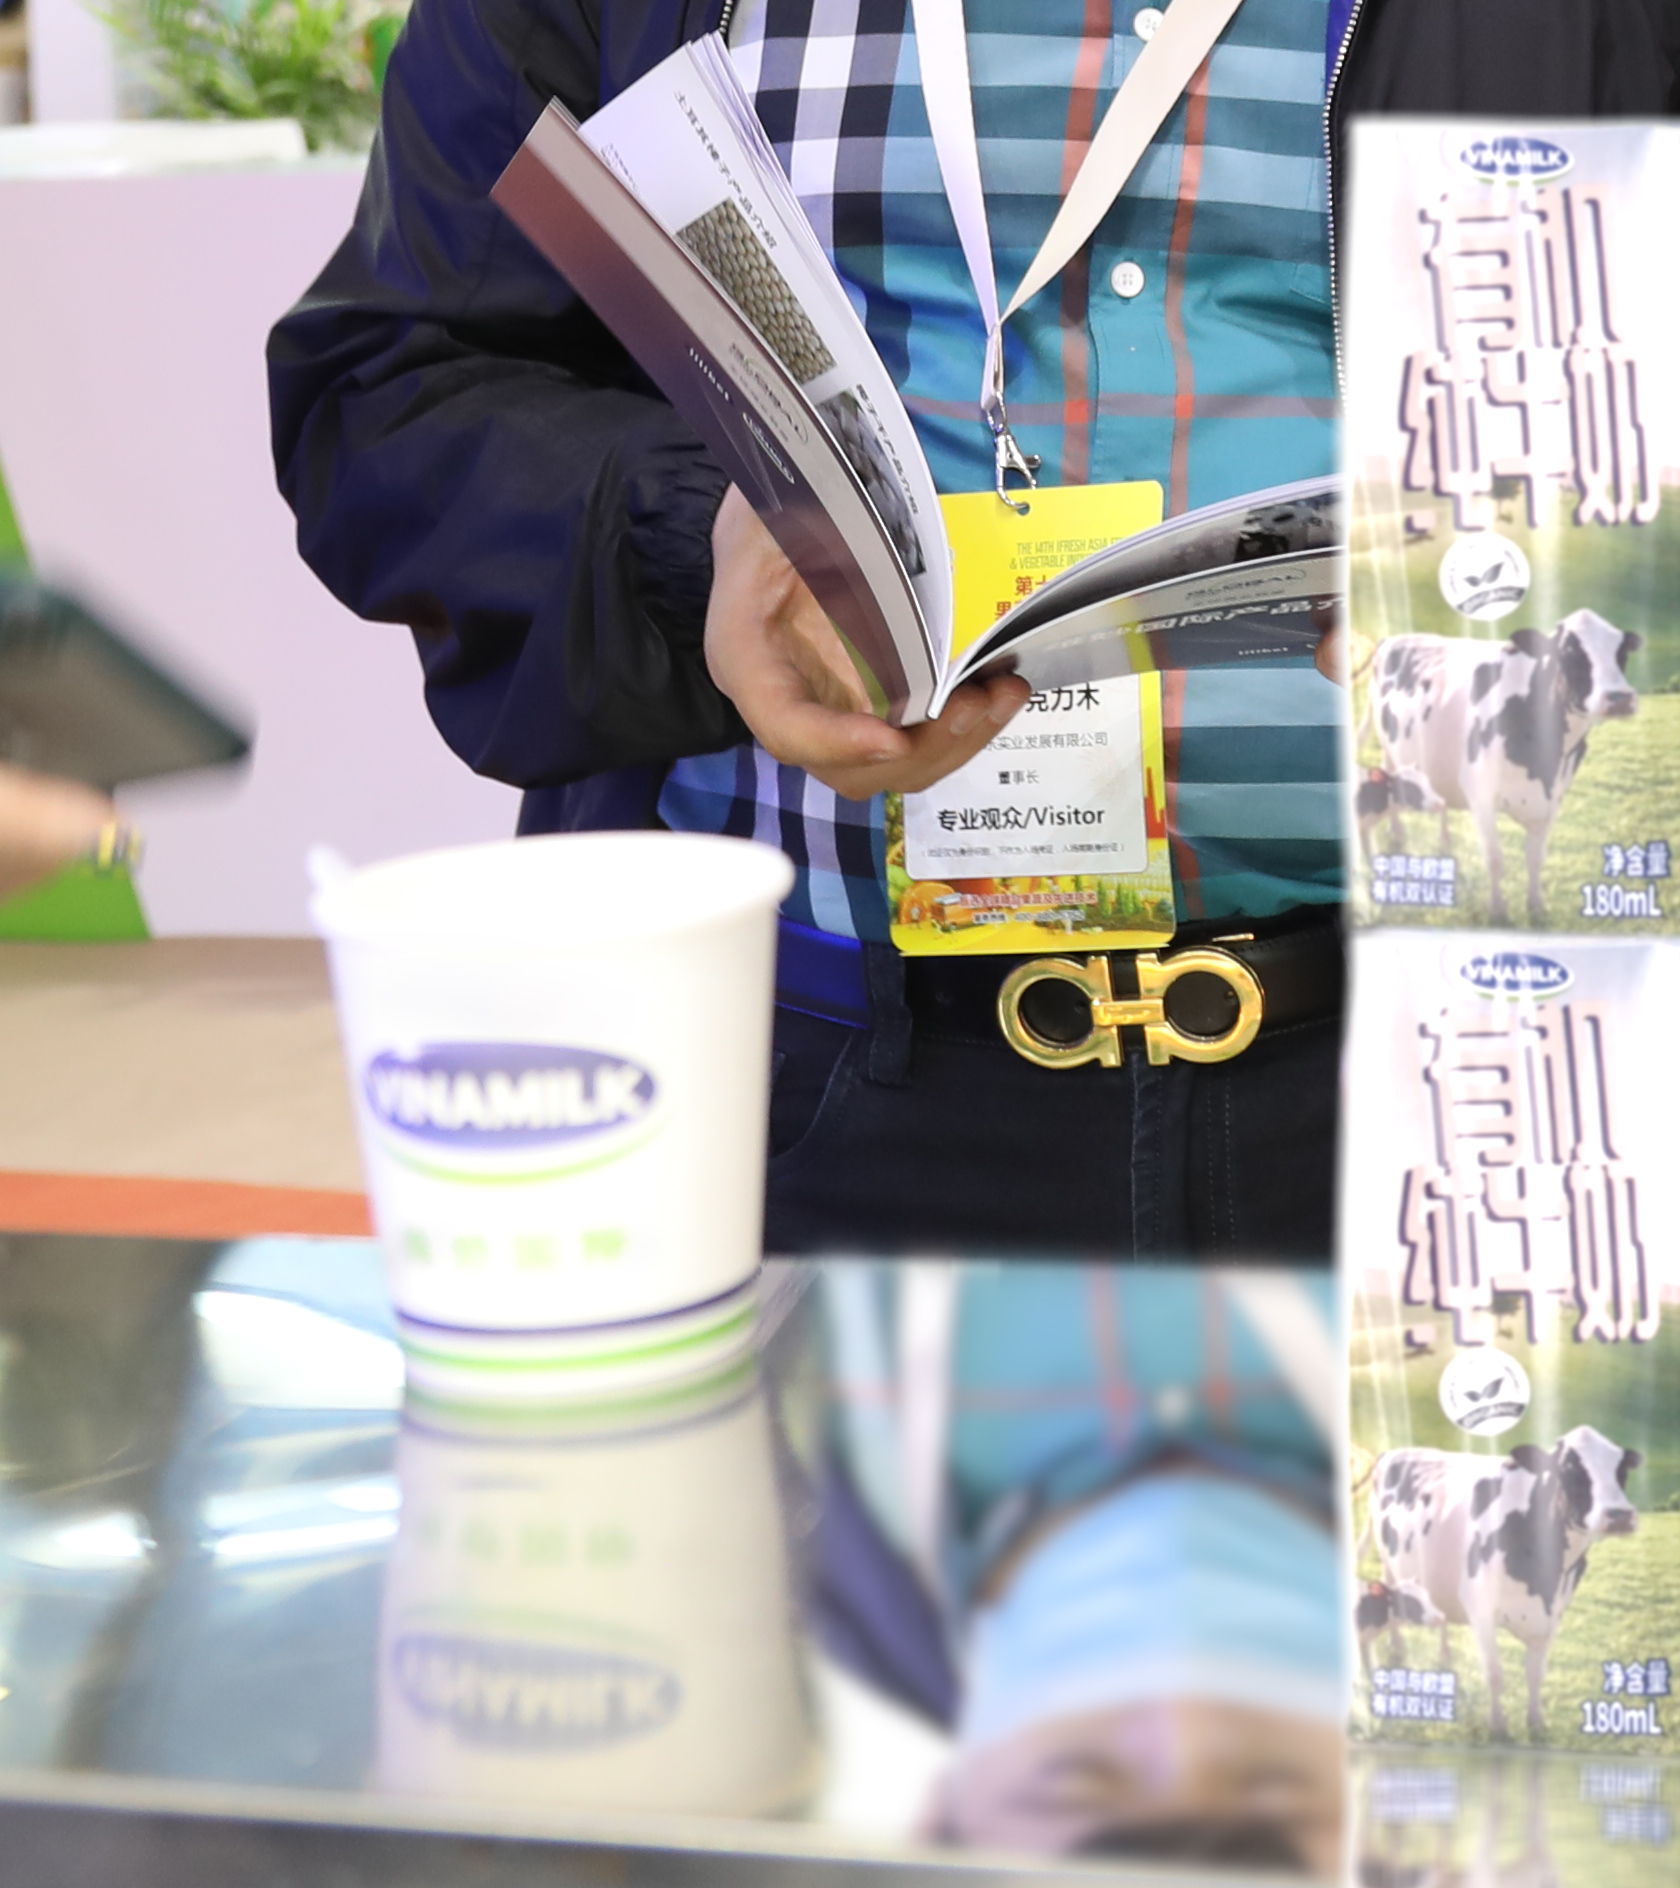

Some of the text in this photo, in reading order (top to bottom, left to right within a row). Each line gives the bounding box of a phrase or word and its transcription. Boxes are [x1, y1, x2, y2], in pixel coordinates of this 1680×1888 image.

[1418, 185, 1621, 358] 有机
[1398, 347, 1659, 534] 纯牛奶
[1025, 683, 1100, 712] 克力木
[997, 768, 1041, 786] 董事长
[1373, 856, 1455, 881] 中国与欧盟
[1604, 842, 1669, 877] 净含量
[1582, 884, 1662, 916] 180mL
[372, 1060, 644, 1132] VINAMILK
[1418, 1000, 1621, 1173] 有机
[1398, 1162, 1659, 1349] 纯牛奶
[1373, 1670, 1455, 1695] 中国与欧盟
[1604, 1660, 1669, 1695] 净含量
[1582, 1701, 1662, 1733] 180mL
